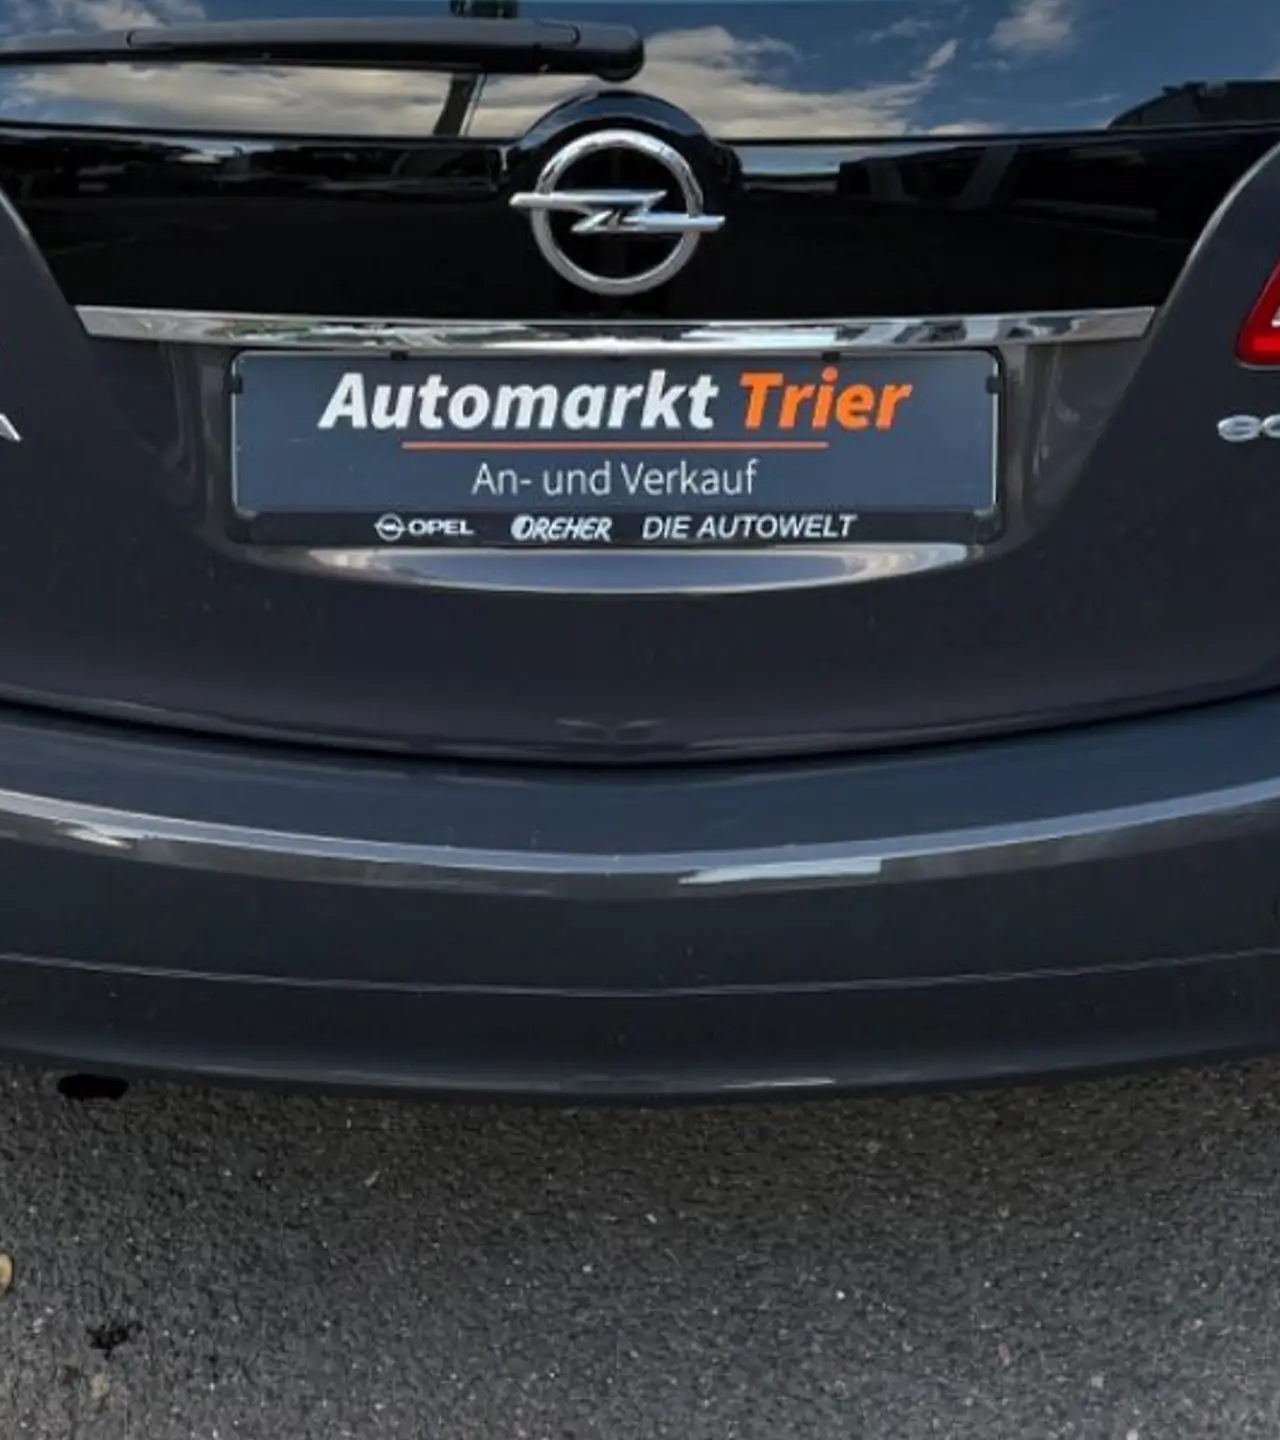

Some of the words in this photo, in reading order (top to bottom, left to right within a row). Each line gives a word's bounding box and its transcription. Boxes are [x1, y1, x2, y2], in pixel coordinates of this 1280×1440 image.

[318, 369, 719, 430] Automarkt
[739, 366, 913, 430] Trier
[470, 461, 532, 496] An-
[543, 460, 612, 496] und
[620, 457, 760, 496] Verkauf
[407, 519, 475, 537] OPEL
[510, 514, 614, 541] DREHER
[641, 514, 692, 540] DIE
[696, 513, 859, 540] AUTOWELT
